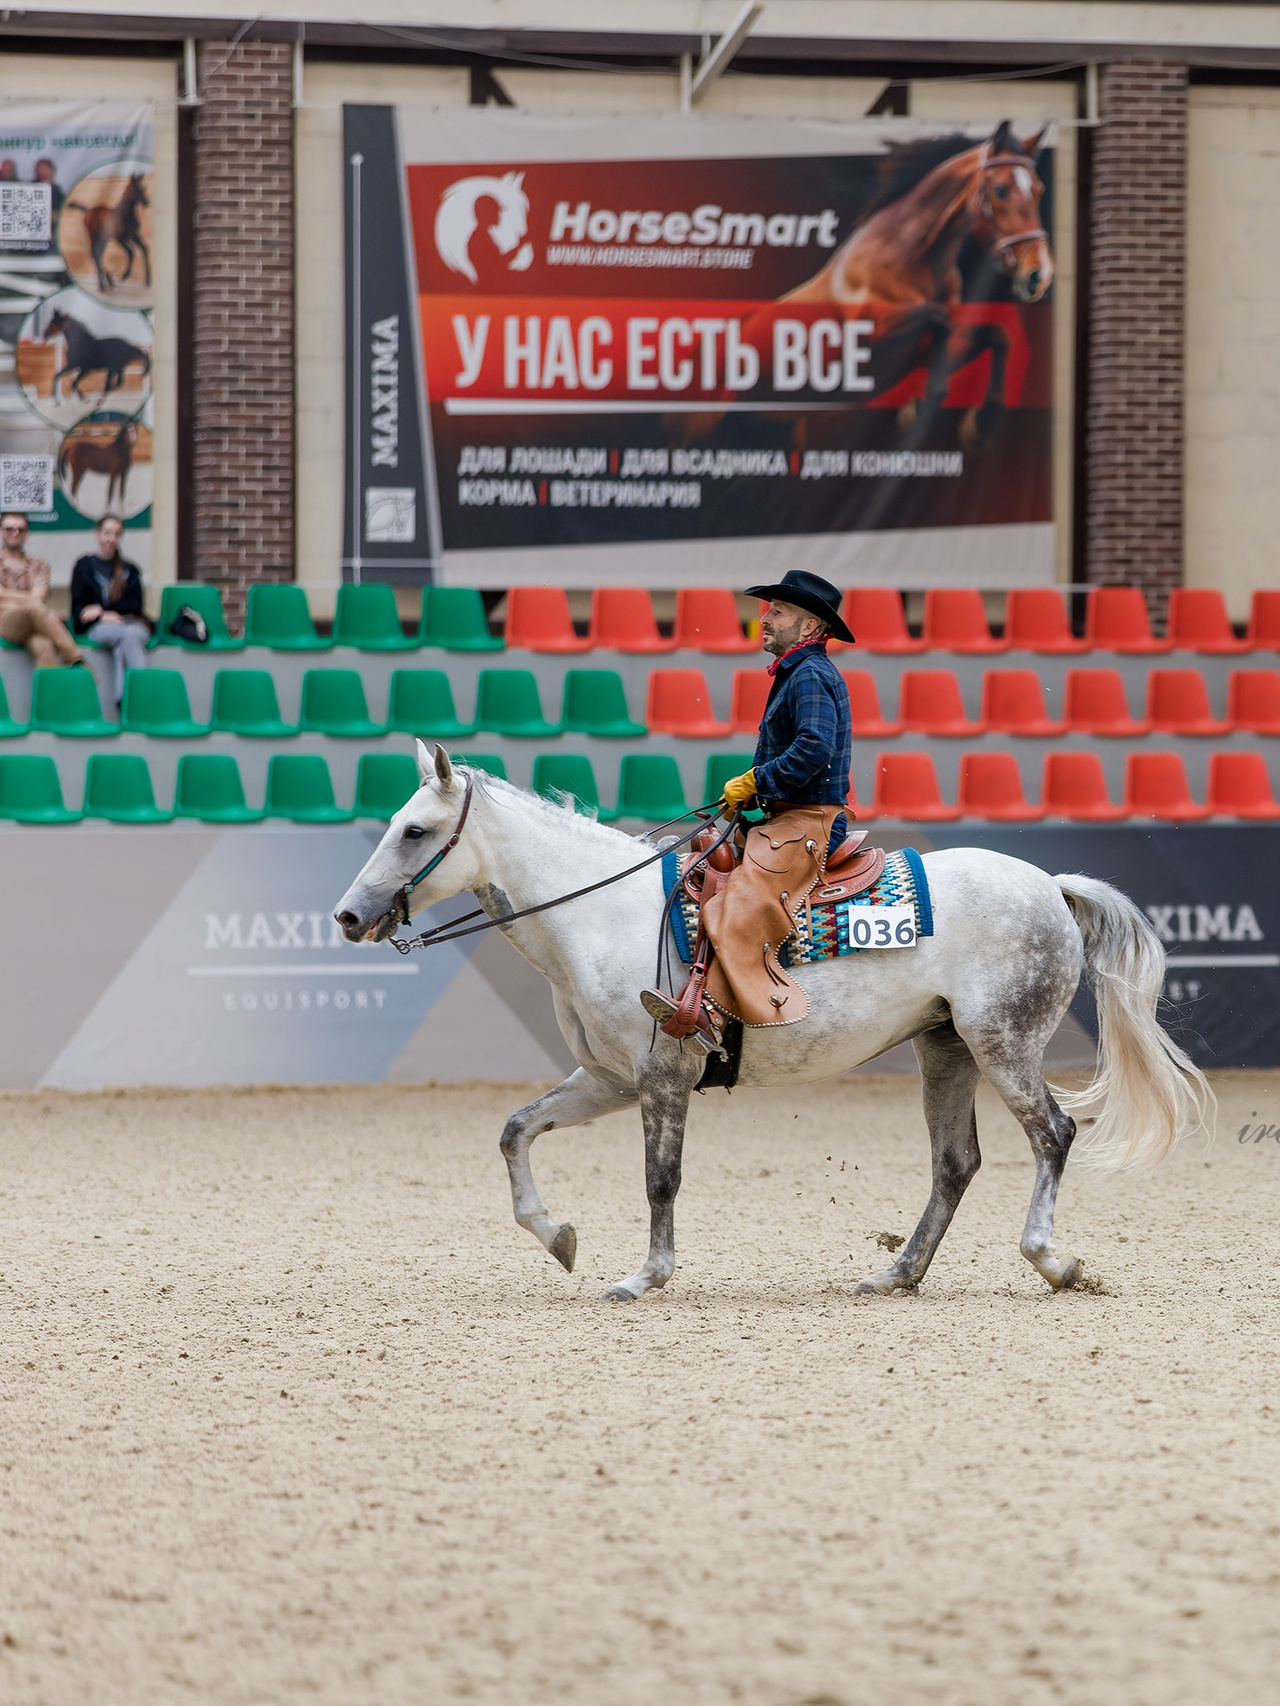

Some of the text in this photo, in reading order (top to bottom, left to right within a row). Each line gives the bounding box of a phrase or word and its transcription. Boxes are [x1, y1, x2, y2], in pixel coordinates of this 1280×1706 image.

[549, 201, 839, 248] HorseSmart
[452, 314, 875, 392] У НАС ЕСТЬ ВСЕ
[371, 314, 399, 468] MAXIMA
[458, 446, 963, 480] ДЛЯ ЛОШАДИ ДЛЯ ВСАДНИКА ДЛЯ КОНЮШНИ
[458, 479, 701, 507] КОРМА ВЕТЕРИНАРИЯ
[205, 911, 392, 950] MAXI
[853, 918, 914, 946] 036
[1146, 904, 1264, 942] XIMA
[223, 989, 388, 1011] EQUISPORT
